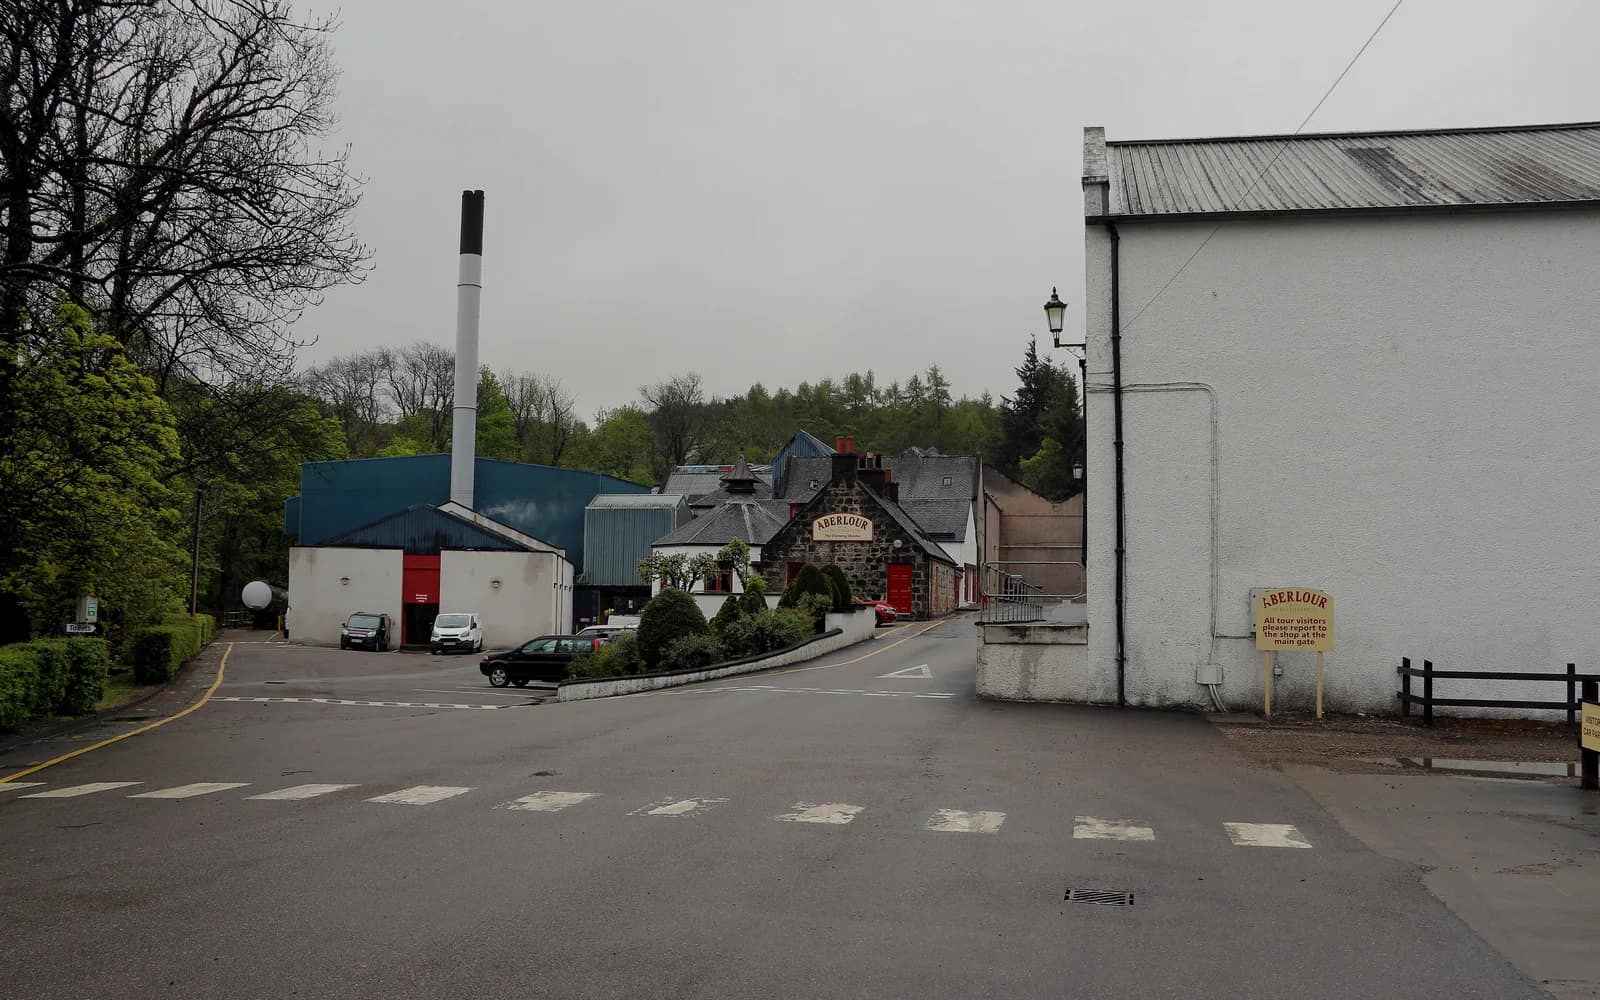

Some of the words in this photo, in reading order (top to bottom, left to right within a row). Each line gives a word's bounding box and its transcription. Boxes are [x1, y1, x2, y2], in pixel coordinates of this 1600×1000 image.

[817, 515, 868, 531] ABERLOUR
[1263, 590, 1328, 608] ABERLOUR
[1262, 624, 1289, 632] please
[1279, 631, 1300, 639] shop
